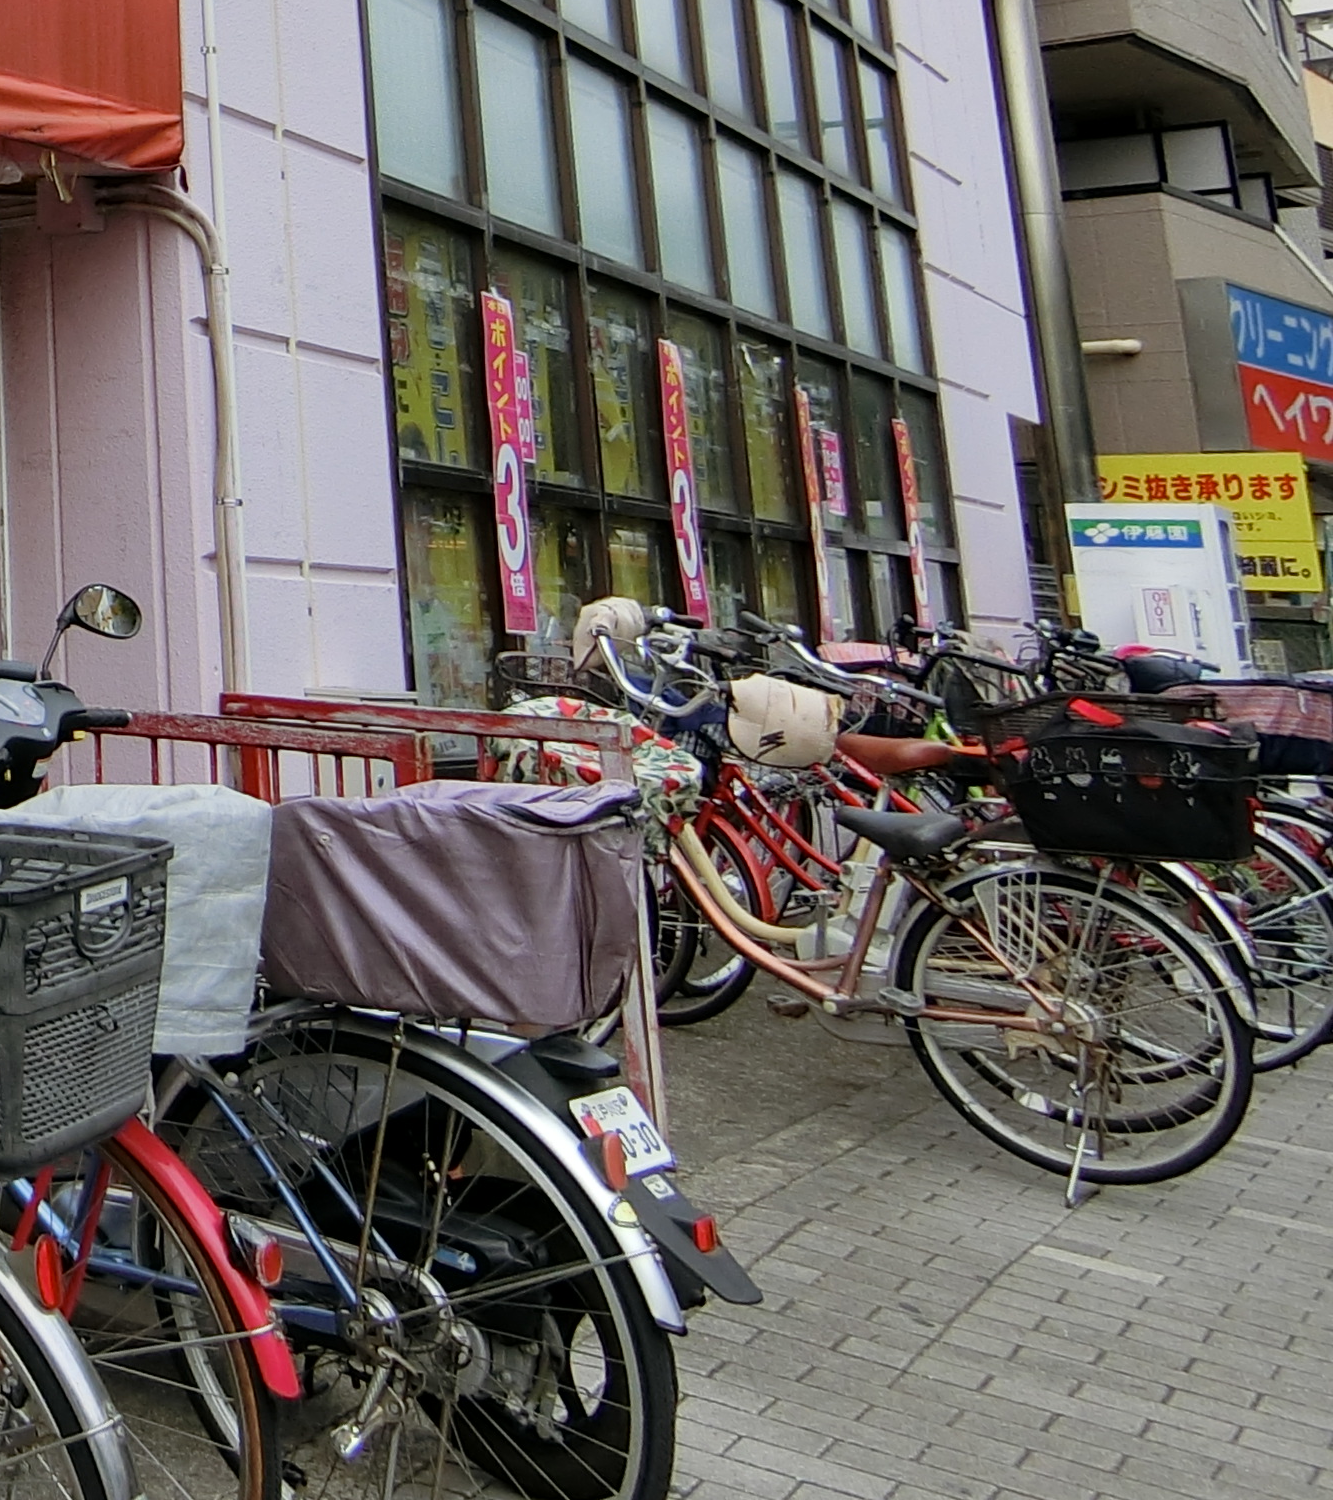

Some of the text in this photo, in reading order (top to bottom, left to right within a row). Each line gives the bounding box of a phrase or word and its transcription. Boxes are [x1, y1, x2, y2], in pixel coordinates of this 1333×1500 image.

[496, 443, 526, 573] 3
[1121, 524, 1189, 543] 伊藤園
